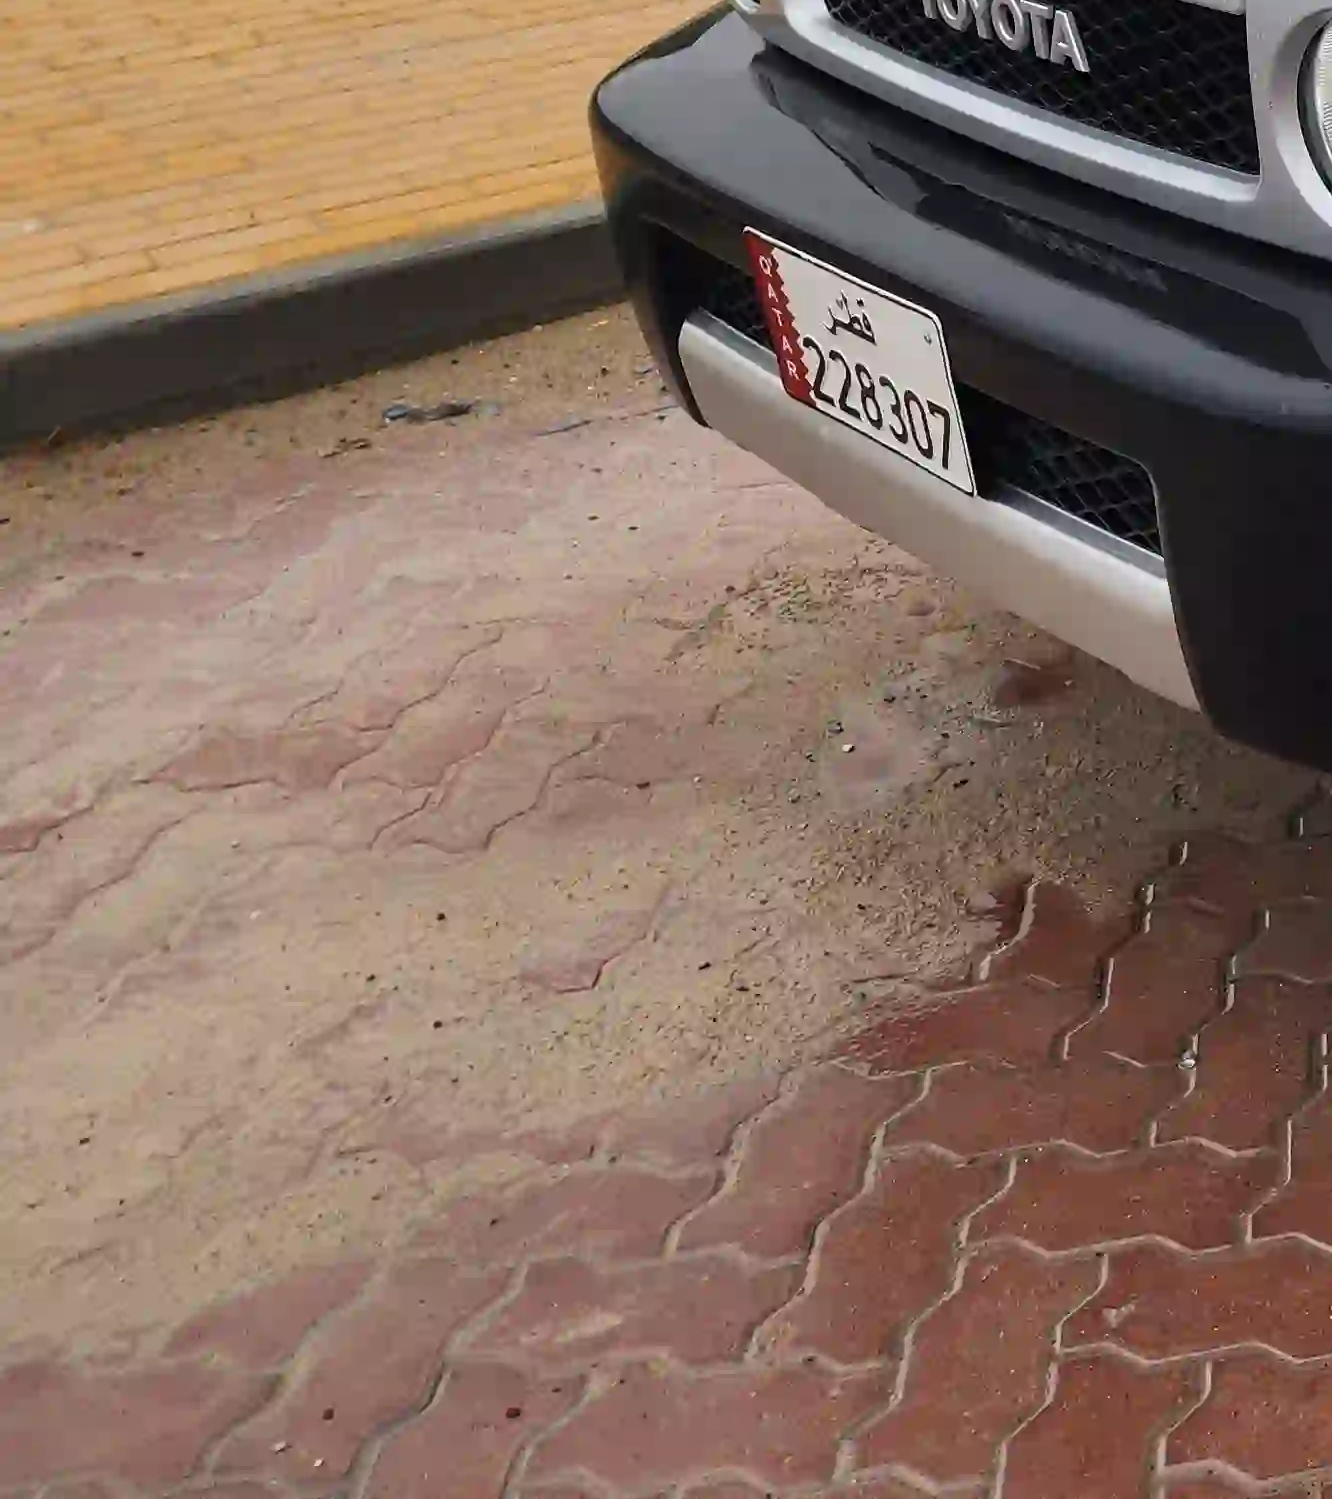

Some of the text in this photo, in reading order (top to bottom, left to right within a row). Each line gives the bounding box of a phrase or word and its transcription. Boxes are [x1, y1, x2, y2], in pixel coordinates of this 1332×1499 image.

[758, 254, 800, 381] QATAR
[820, 290, 877, 346] قطر
[802, 333, 952, 471] 228307
